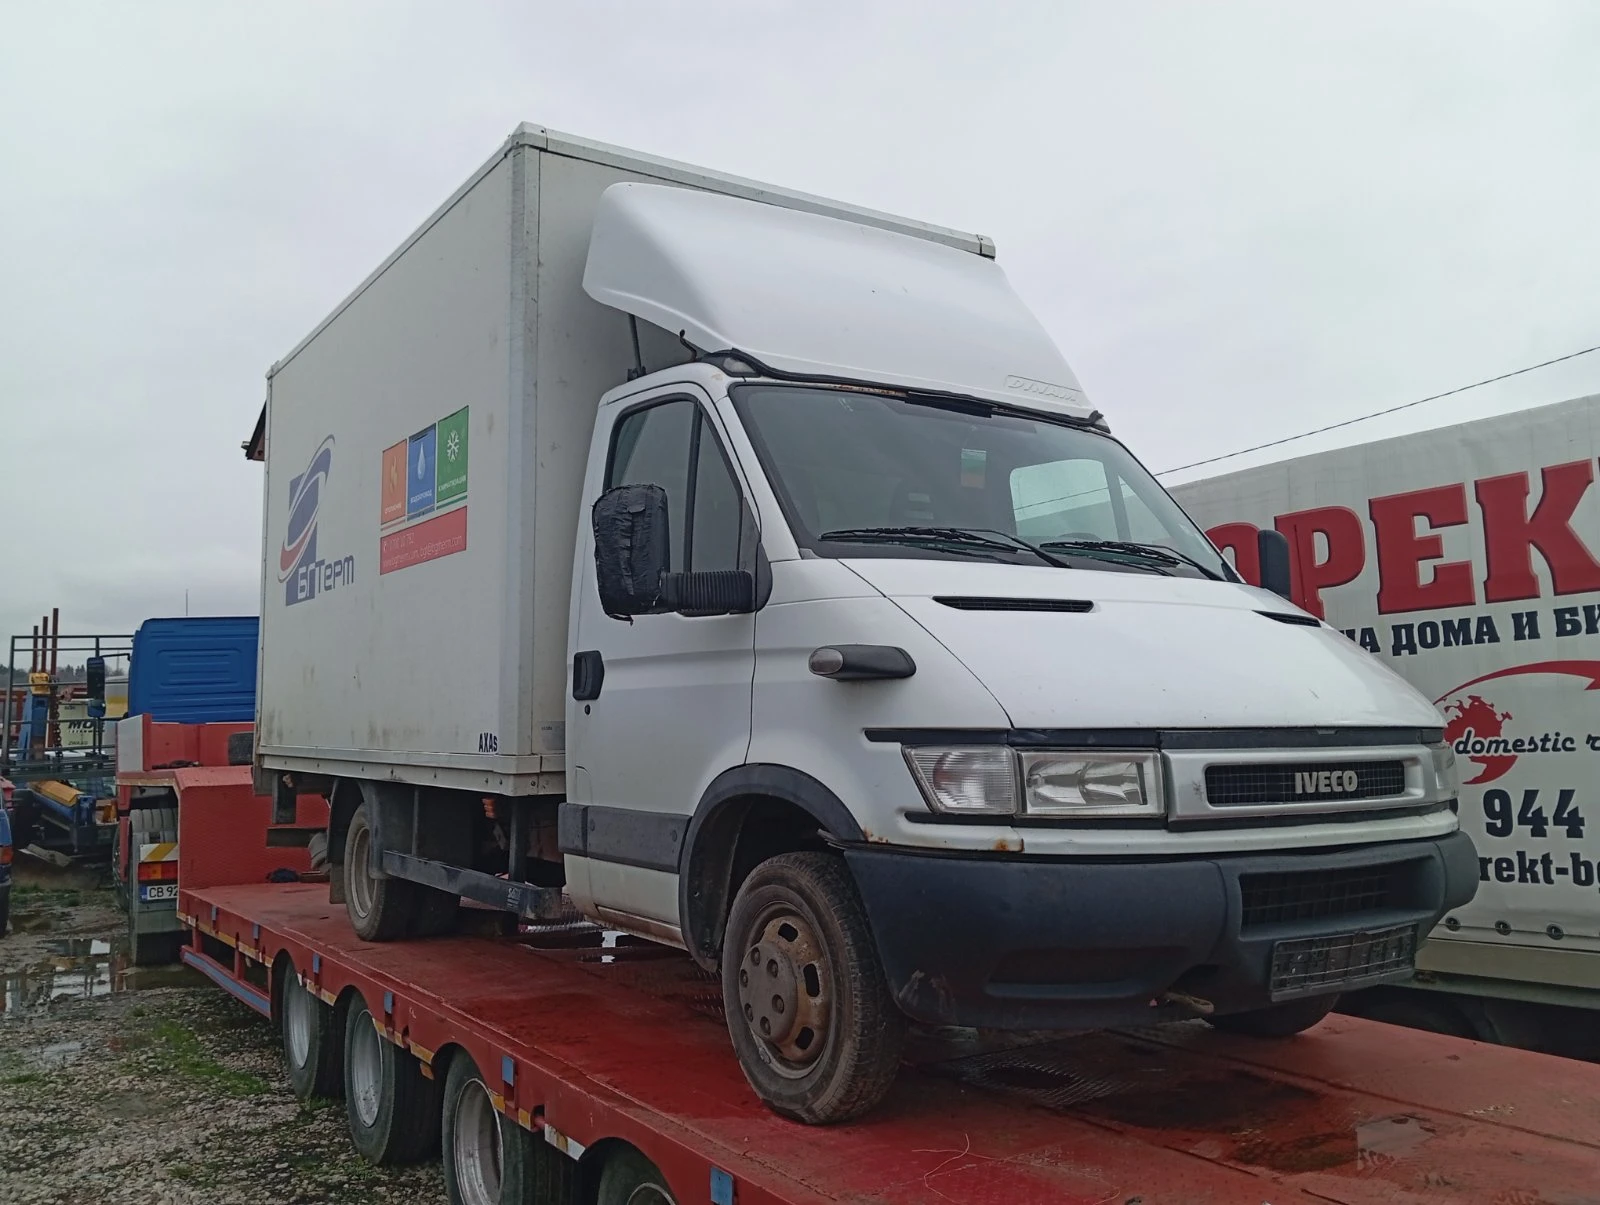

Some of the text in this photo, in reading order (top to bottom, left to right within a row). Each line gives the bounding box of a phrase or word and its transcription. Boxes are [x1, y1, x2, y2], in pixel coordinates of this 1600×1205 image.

[1391, 615, 1500, 656] ДОМА
[1511, 610, 1540, 641] И
[1455, 729, 1576, 754] domestic
[1295, 770, 1358, 794] IVECO
[1483, 789, 1585, 838] 944
[150, 887, 164, 898] CB
